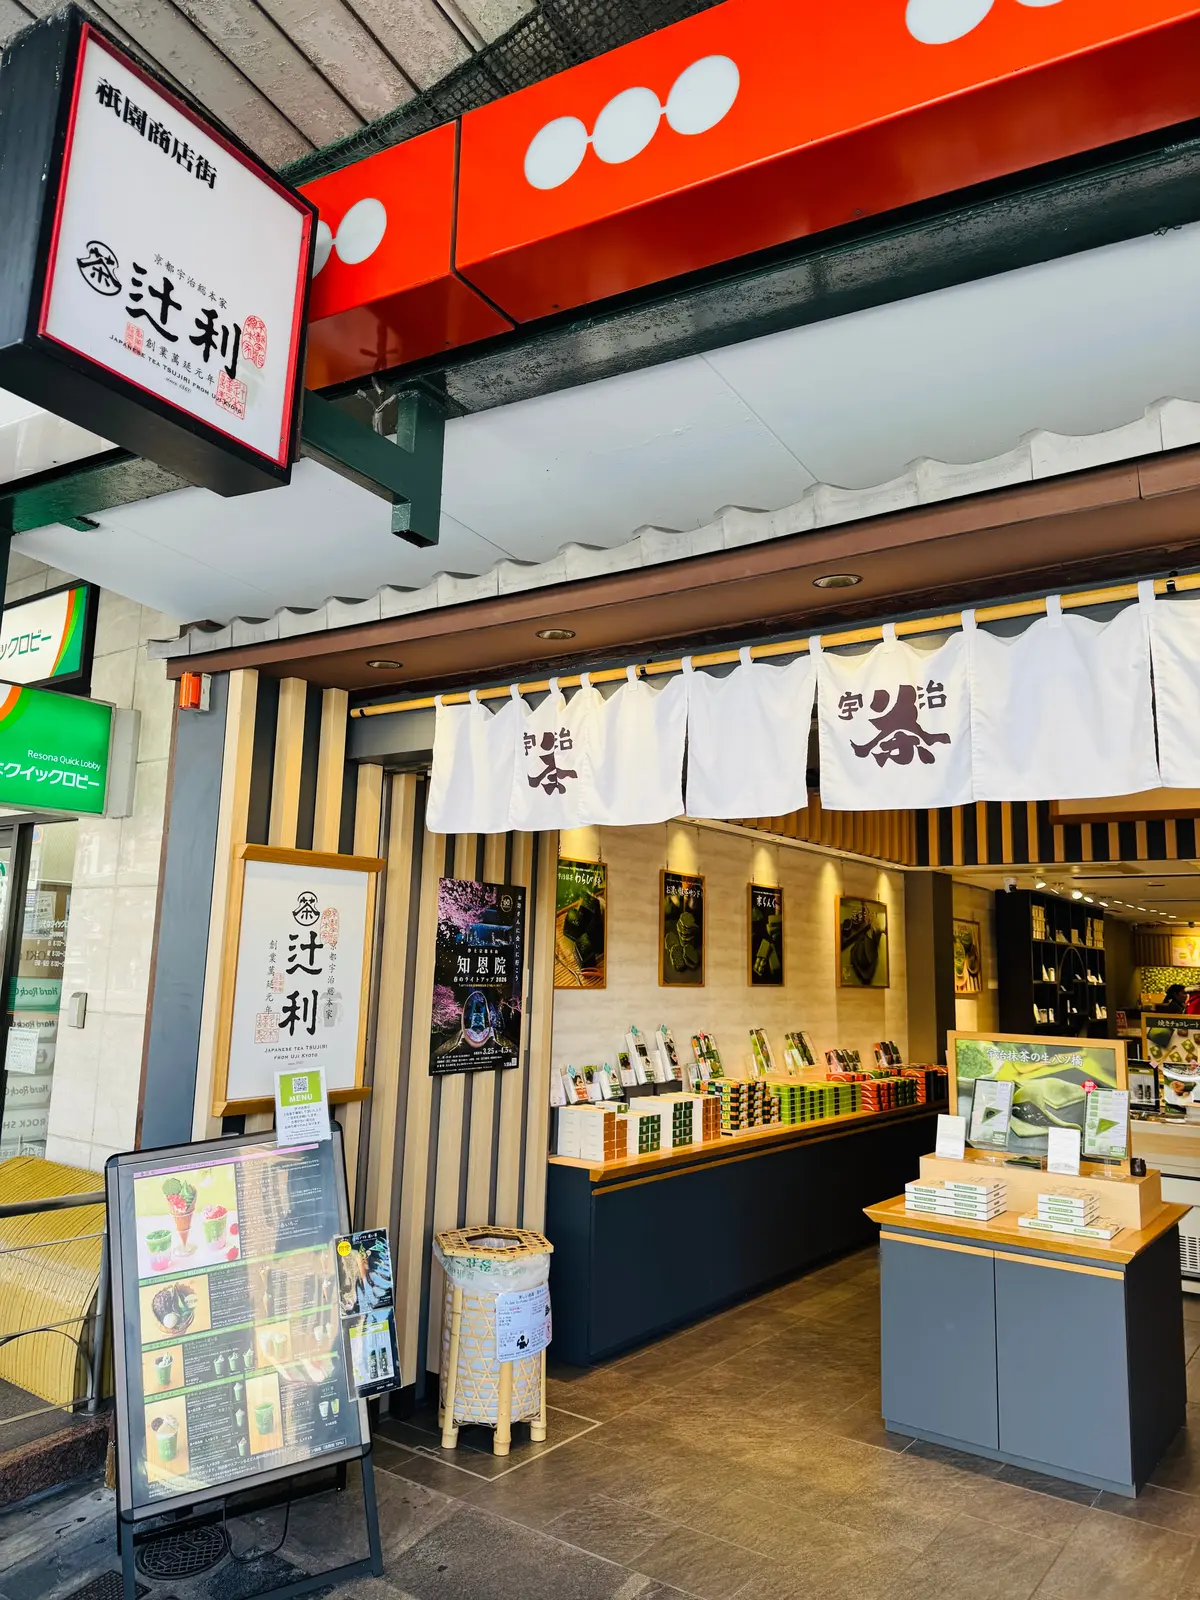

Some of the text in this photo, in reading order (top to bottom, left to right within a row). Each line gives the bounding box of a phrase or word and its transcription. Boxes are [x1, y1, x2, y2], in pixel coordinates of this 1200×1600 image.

[125, 262, 241, 380] 辻利
[109, 335, 145, 358] JAPANESE
[148, 356, 161, 367] TEA
[162, 364, 191, 384] TSUJIRI
[192, 382, 209, 396] FROM
[28, 750, 101, 771] Resona Quick Lobby
[456, 955, 507, 975] 知恩院
[278, 930, 324, 1036] 辻利
[986, 1048, 1085, 1067] 宇治抹茶の生八ツ橋
[289, 1093, 313, 1103] MENU
